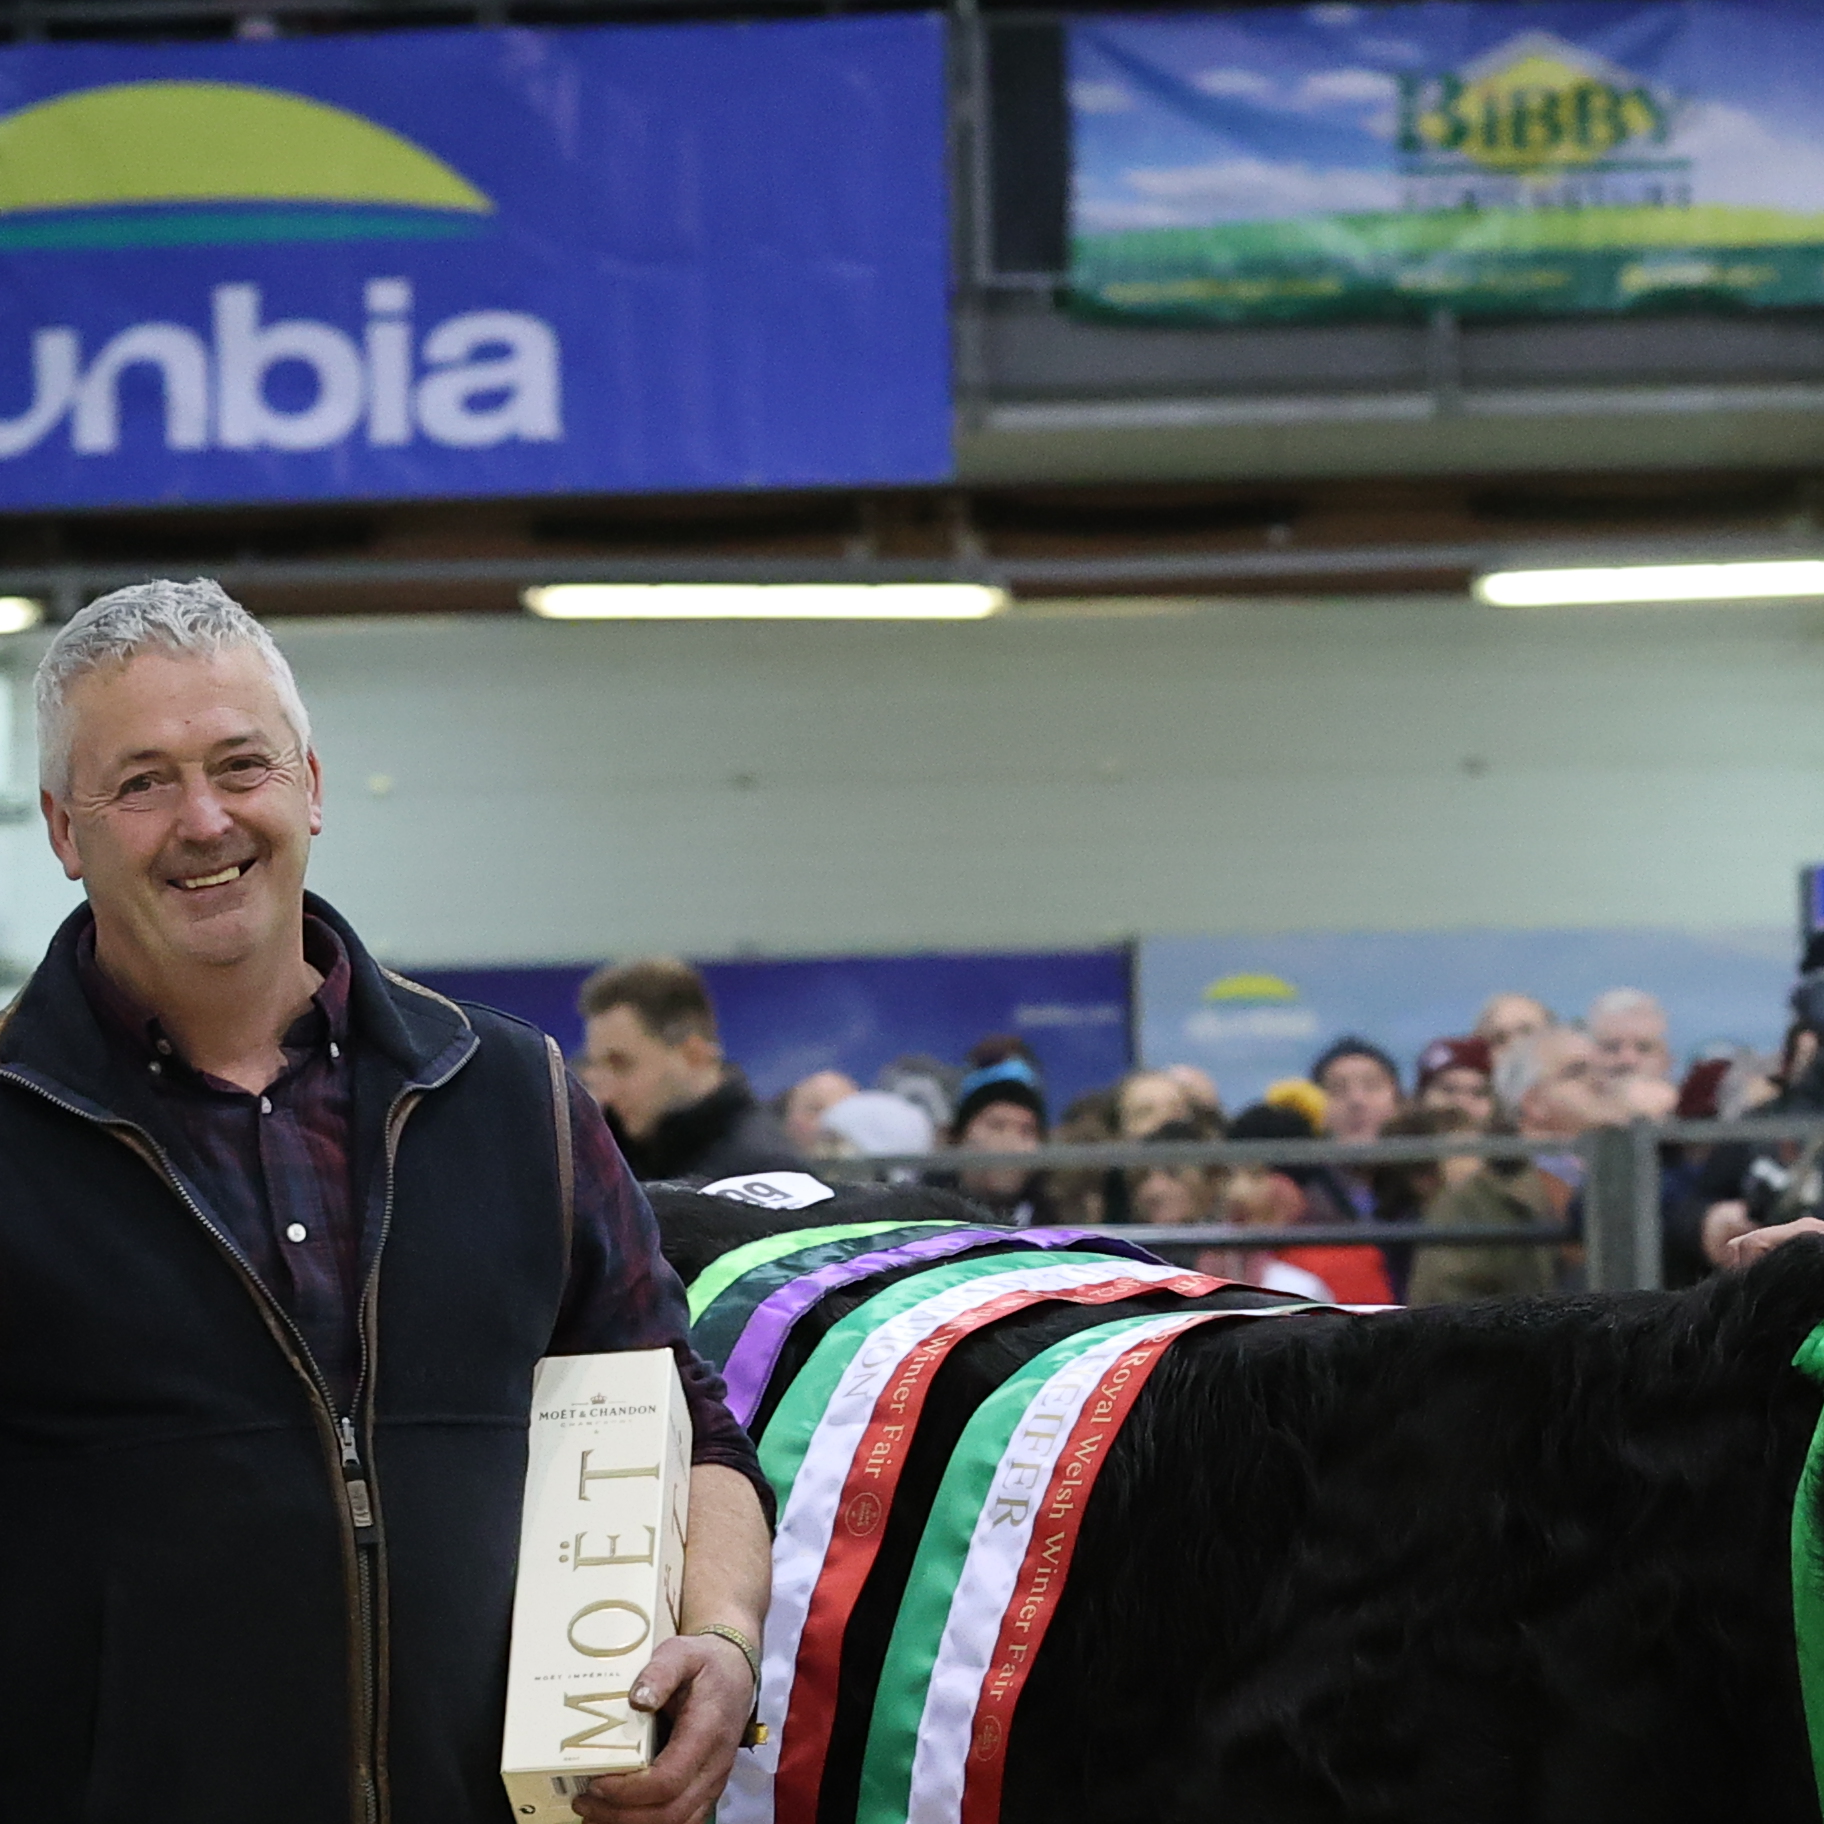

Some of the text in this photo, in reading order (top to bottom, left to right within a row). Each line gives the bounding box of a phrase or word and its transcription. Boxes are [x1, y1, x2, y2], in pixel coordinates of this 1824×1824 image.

[539, 1405, 657, 1421] MOËT & CHANDON
[889, 1333, 956, 1417] Winter
[1090, 1350, 1153, 1424] Royal
[864, 1424, 905, 1480] Fair
[1049, 1434, 1104, 1520] Welsh
[559, 1449, 661, 1755] MOËT
[1014, 1531, 1066, 1634] Winter
[989, 1643, 1029, 1702] Fair
